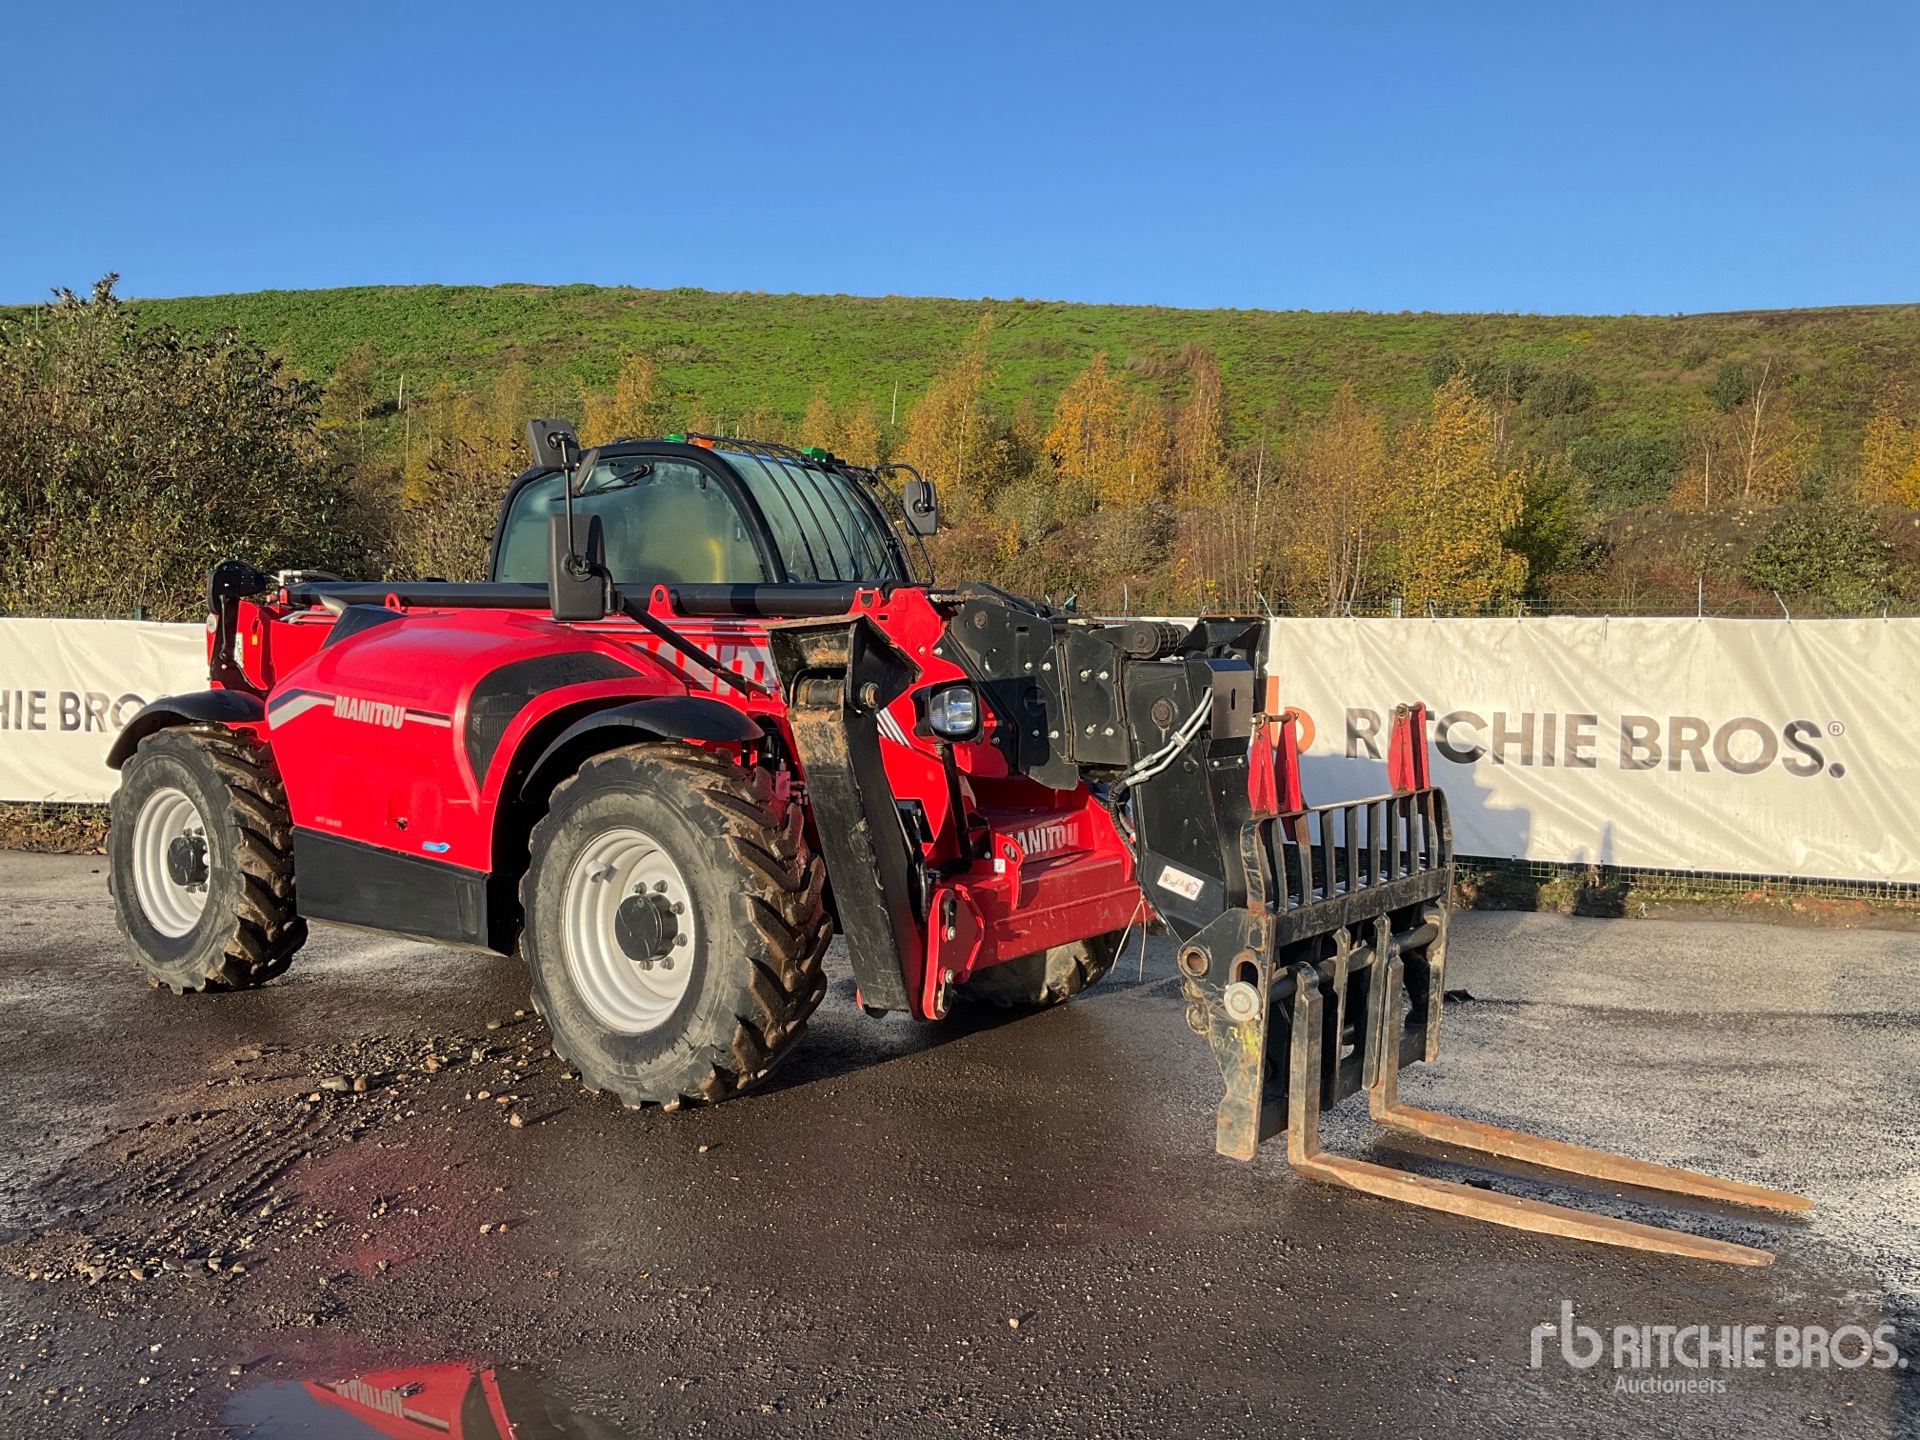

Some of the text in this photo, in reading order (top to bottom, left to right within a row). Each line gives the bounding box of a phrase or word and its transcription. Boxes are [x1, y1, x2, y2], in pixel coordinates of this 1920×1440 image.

[59, 690, 174, 732] BRO
[333, 695, 405, 729] MANITOU
[1345, 708, 1598, 768] RCHIE
